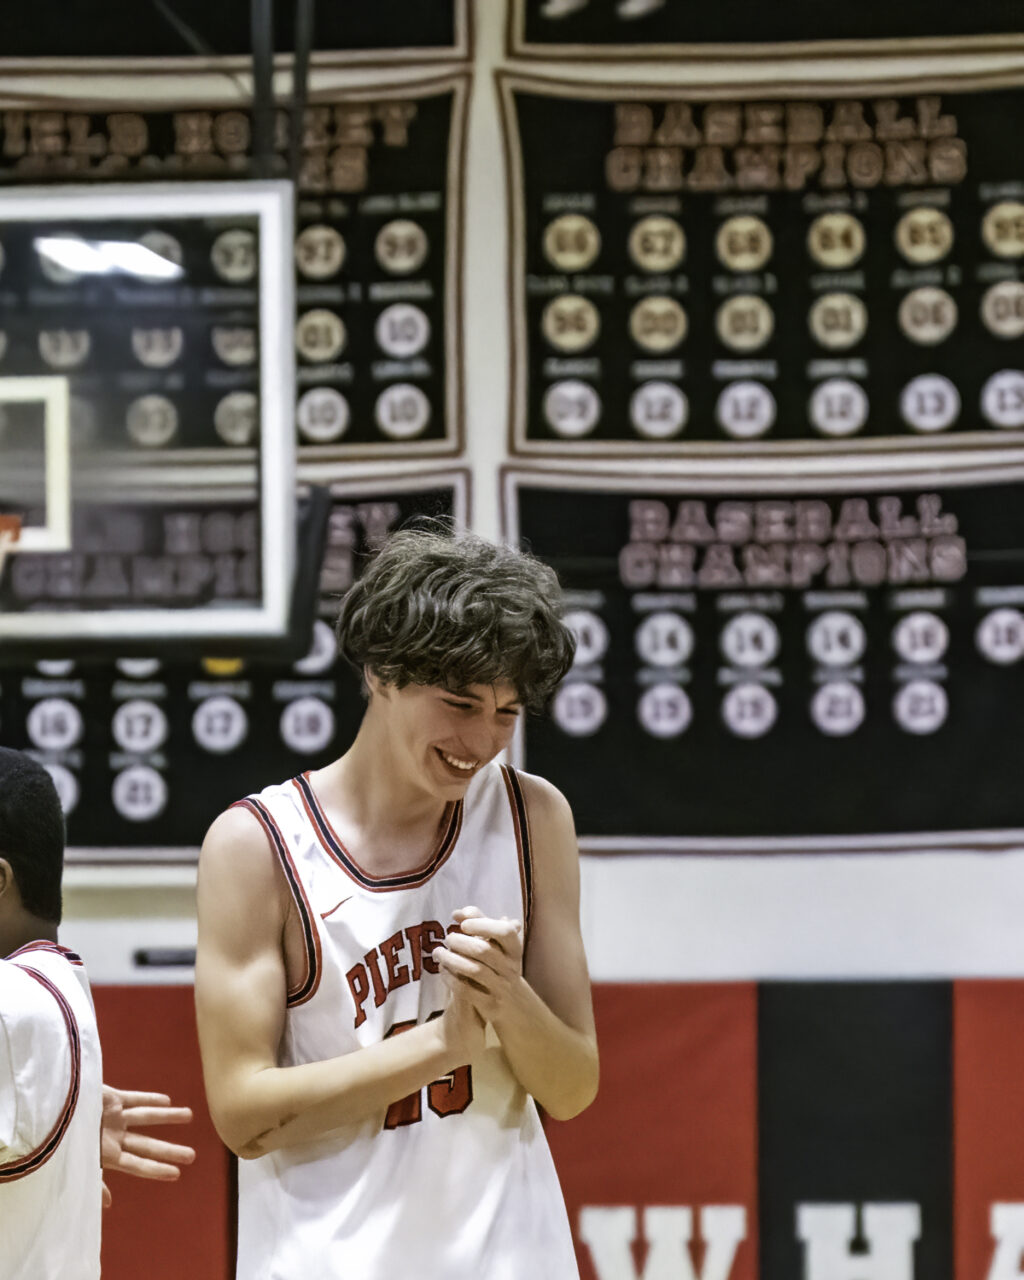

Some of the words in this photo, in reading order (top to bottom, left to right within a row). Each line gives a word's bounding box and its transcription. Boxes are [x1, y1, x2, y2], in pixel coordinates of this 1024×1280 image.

[614, 95, 958, 147] BASEBALL
[606, 136, 968, 192] CHAMPIONS
[629, 493, 959, 543] BASEBALL
[618, 532, 968, 589] CHAMPIONS
[345, 919, 464, 1030] PIES
